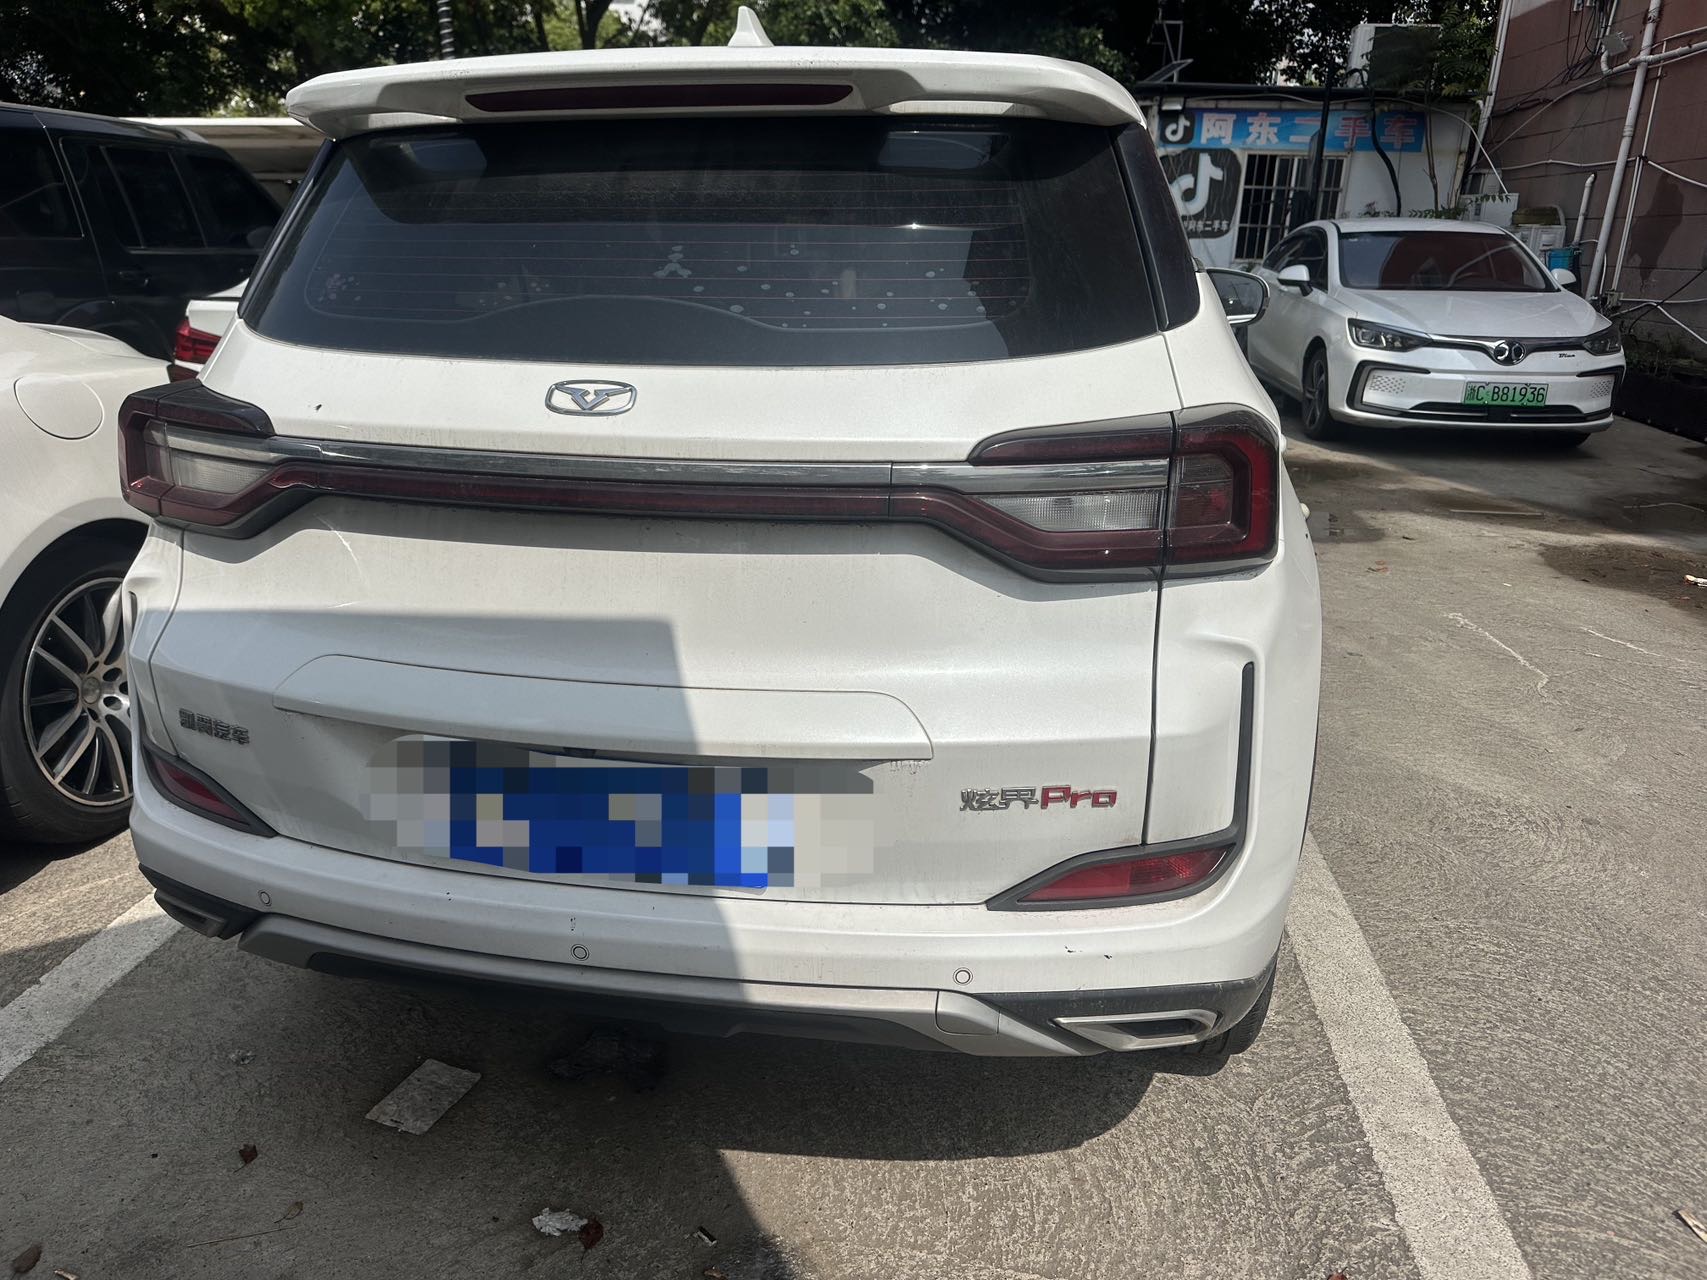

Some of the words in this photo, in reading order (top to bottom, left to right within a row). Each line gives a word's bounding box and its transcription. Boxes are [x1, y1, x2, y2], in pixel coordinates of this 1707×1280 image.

[1201, 112, 1417, 149] 阿东二手车
